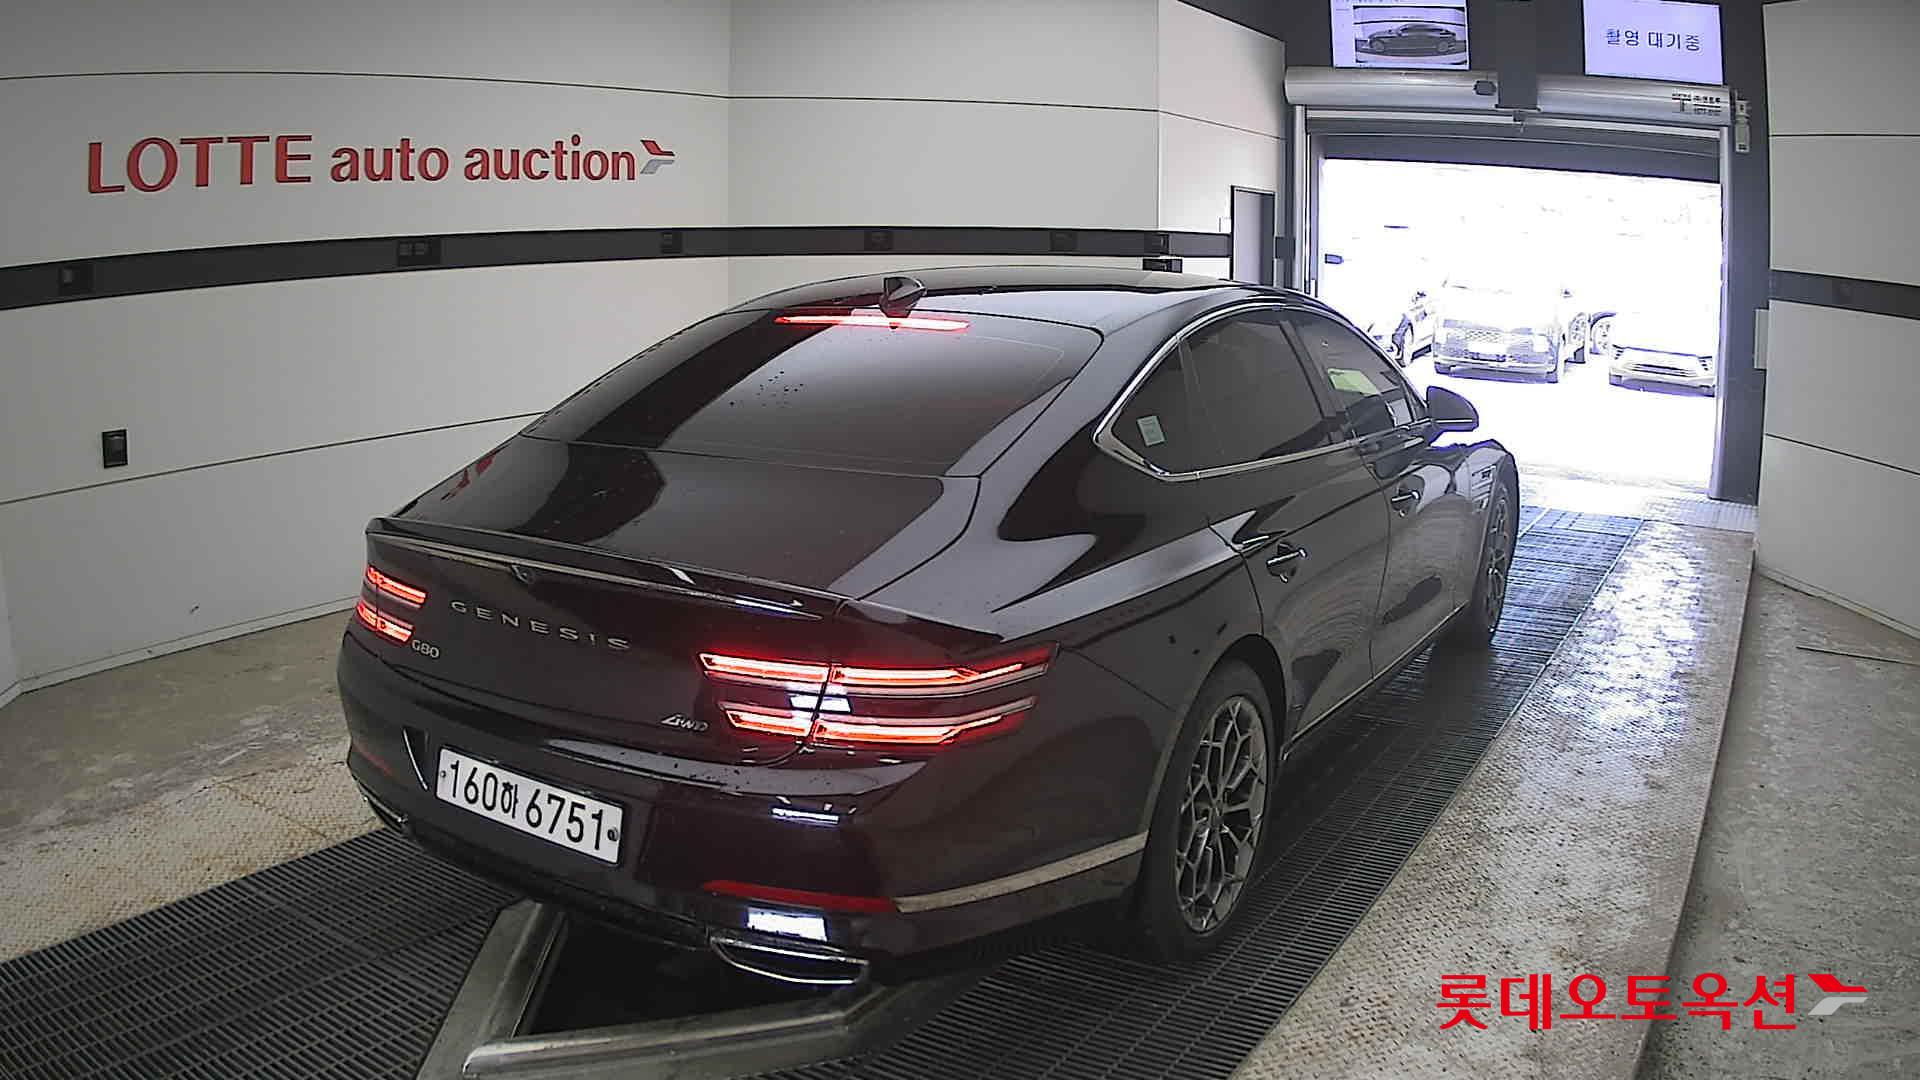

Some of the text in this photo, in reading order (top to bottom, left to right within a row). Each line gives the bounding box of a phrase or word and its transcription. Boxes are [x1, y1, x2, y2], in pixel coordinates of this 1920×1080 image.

[1647, 31, 1700, 52] 대기중
[88, 134, 636, 194] LOTTE auto auction
[411, 639, 441, 659] G80
[450, 600, 630, 650] GENESIS
[450, 759, 604, 851] 160하 6751
